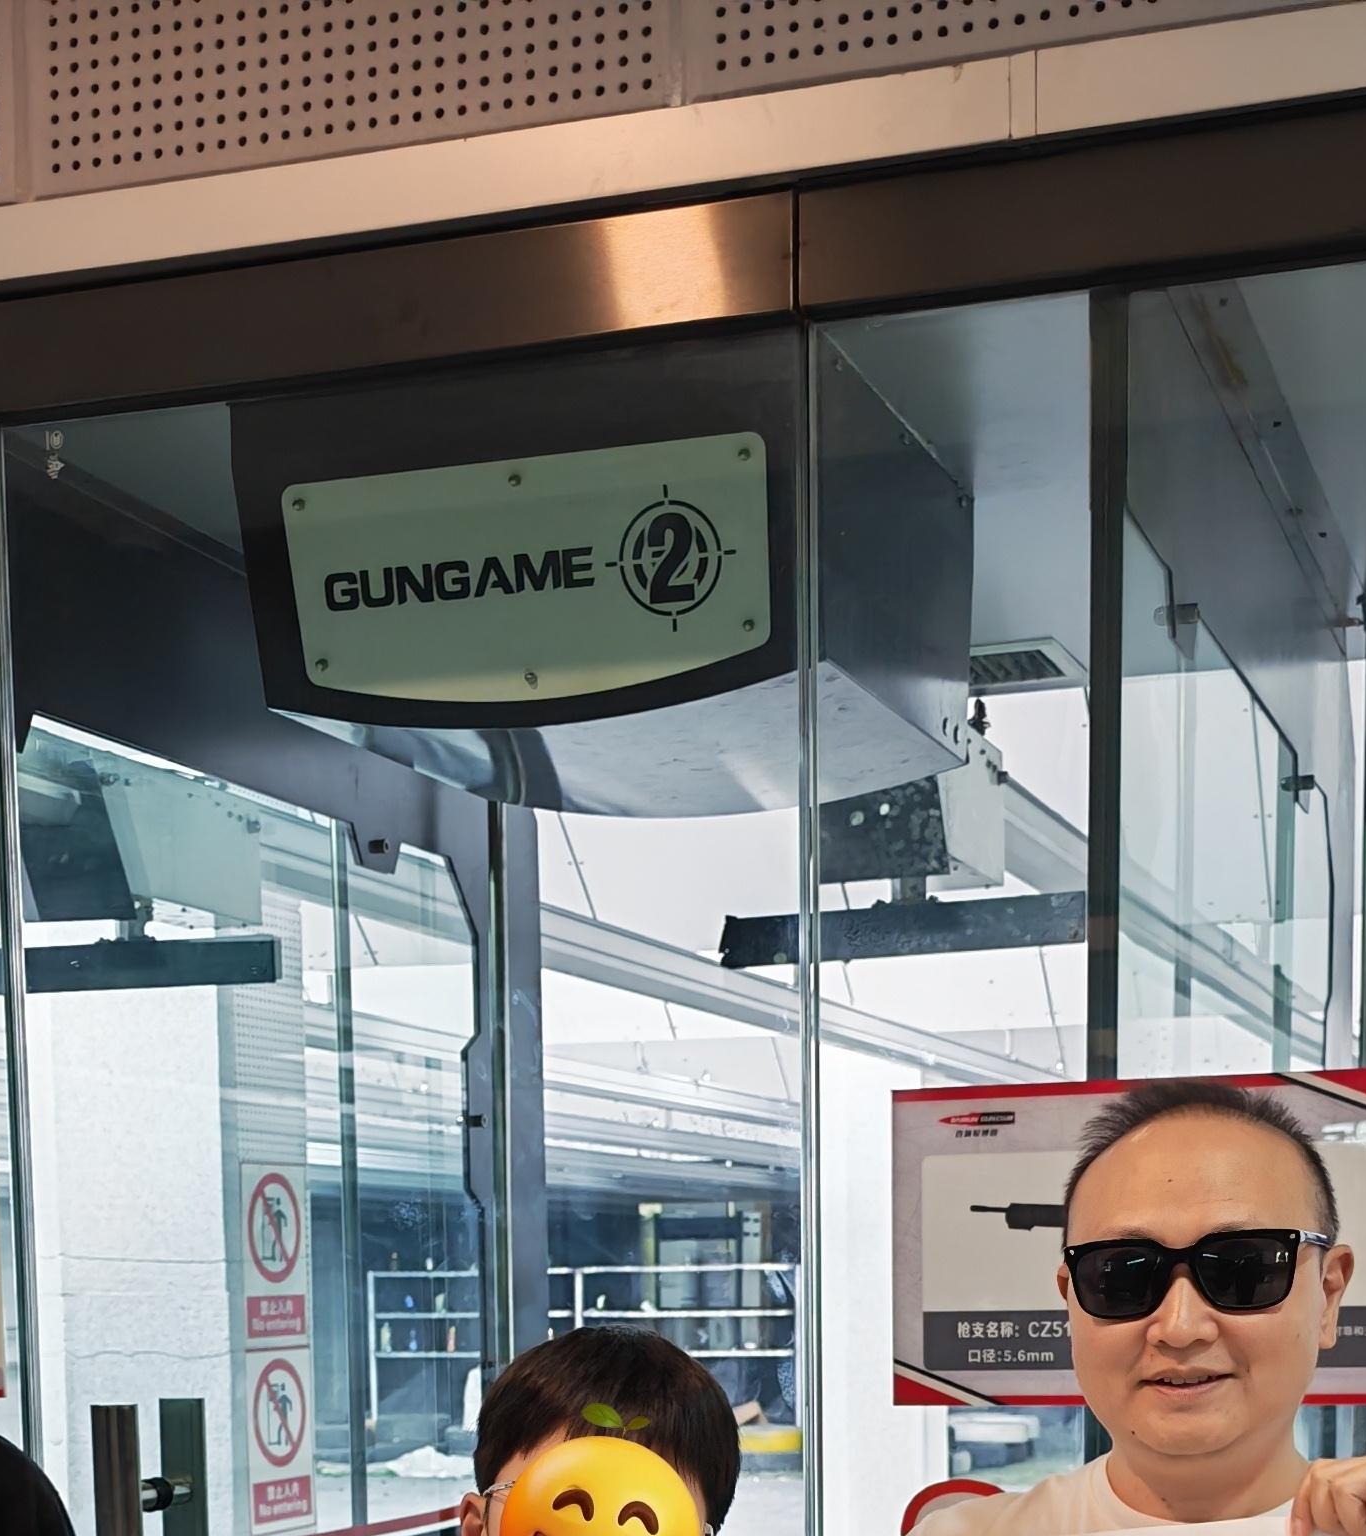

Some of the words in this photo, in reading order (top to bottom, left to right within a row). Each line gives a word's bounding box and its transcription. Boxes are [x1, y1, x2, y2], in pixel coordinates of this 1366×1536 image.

[325, 546, 595, 611] GUNGAME
[648, 512, 696, 605] 2
[957, 1321, 1020, 1338] 枪支名称：
